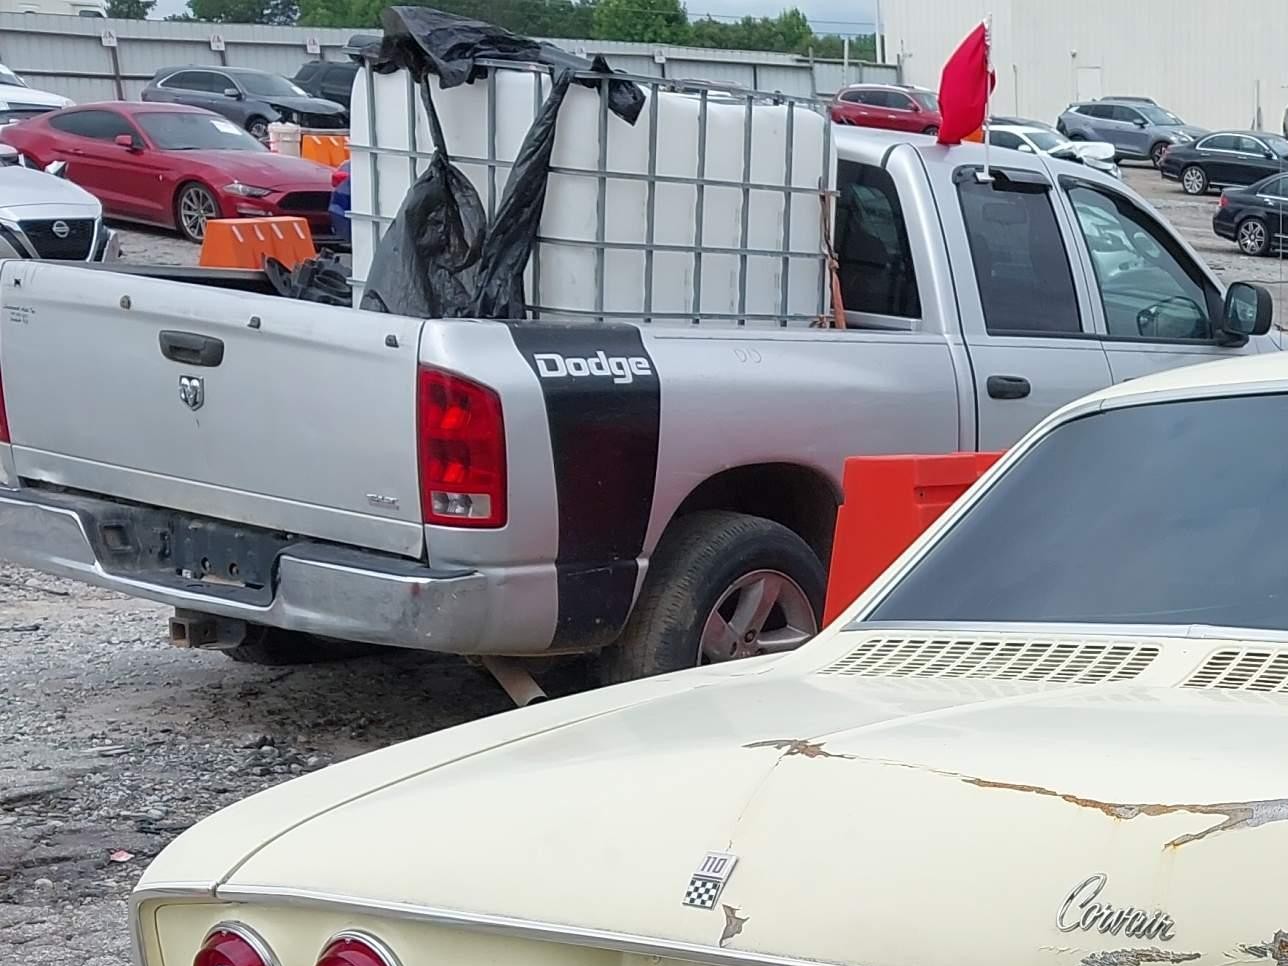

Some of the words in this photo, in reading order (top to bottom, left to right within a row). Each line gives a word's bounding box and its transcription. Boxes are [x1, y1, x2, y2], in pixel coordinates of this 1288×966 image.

[533, 350, 652, 384] Dodge
[700, 855, 728, 874] 110
[1056, 872, 1176, 941] Corvair
